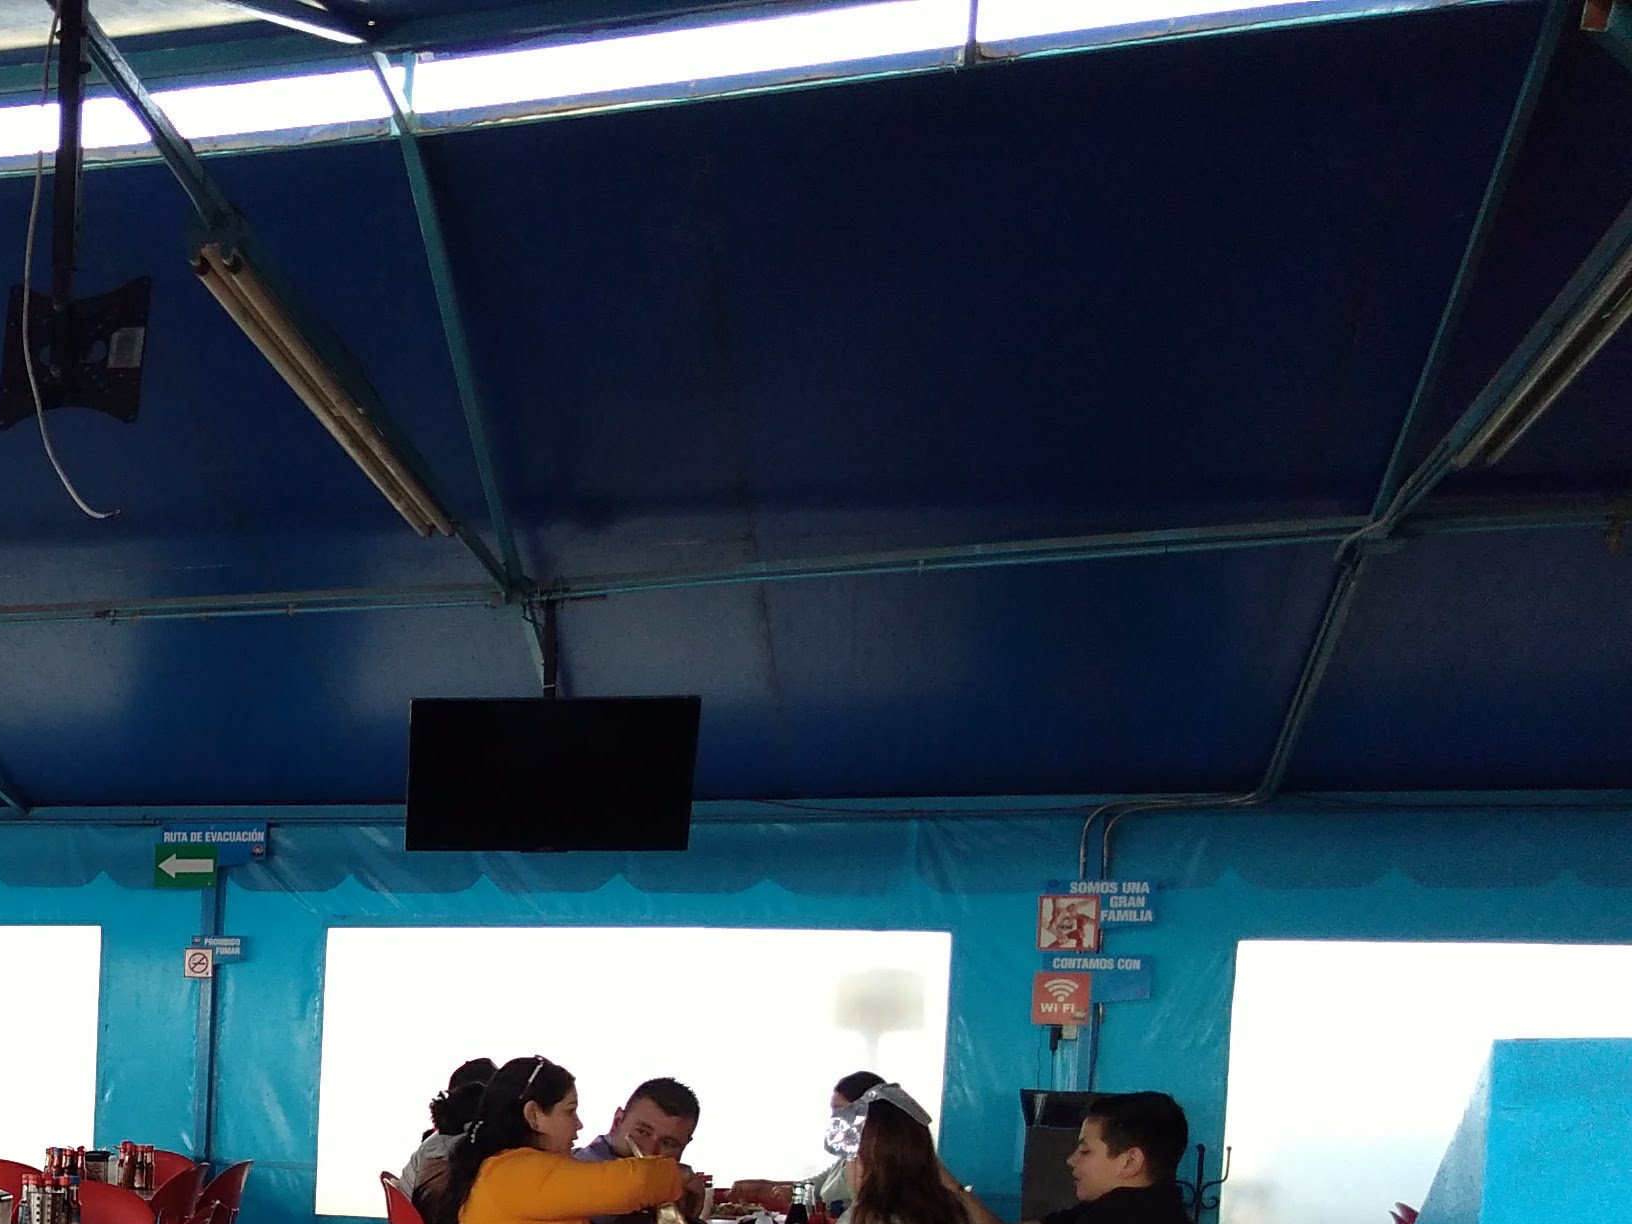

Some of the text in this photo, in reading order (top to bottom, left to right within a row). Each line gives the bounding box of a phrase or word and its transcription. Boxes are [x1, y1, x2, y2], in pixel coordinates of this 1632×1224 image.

[164, 829, 264, 843] RUTA DE EVACUACIÓN
[1069, 881, 1150, 894] SOMOS UNA
[1109, 895, 1145, 908] GRAN
[1100, 910, 1153, 922] FAMILIA
[204, 938, 241, 946] PROHIBIDO
[216, 946, 240, 955] FUMAR
[1052, 957, 1141, 970] CONTAMOS CON
